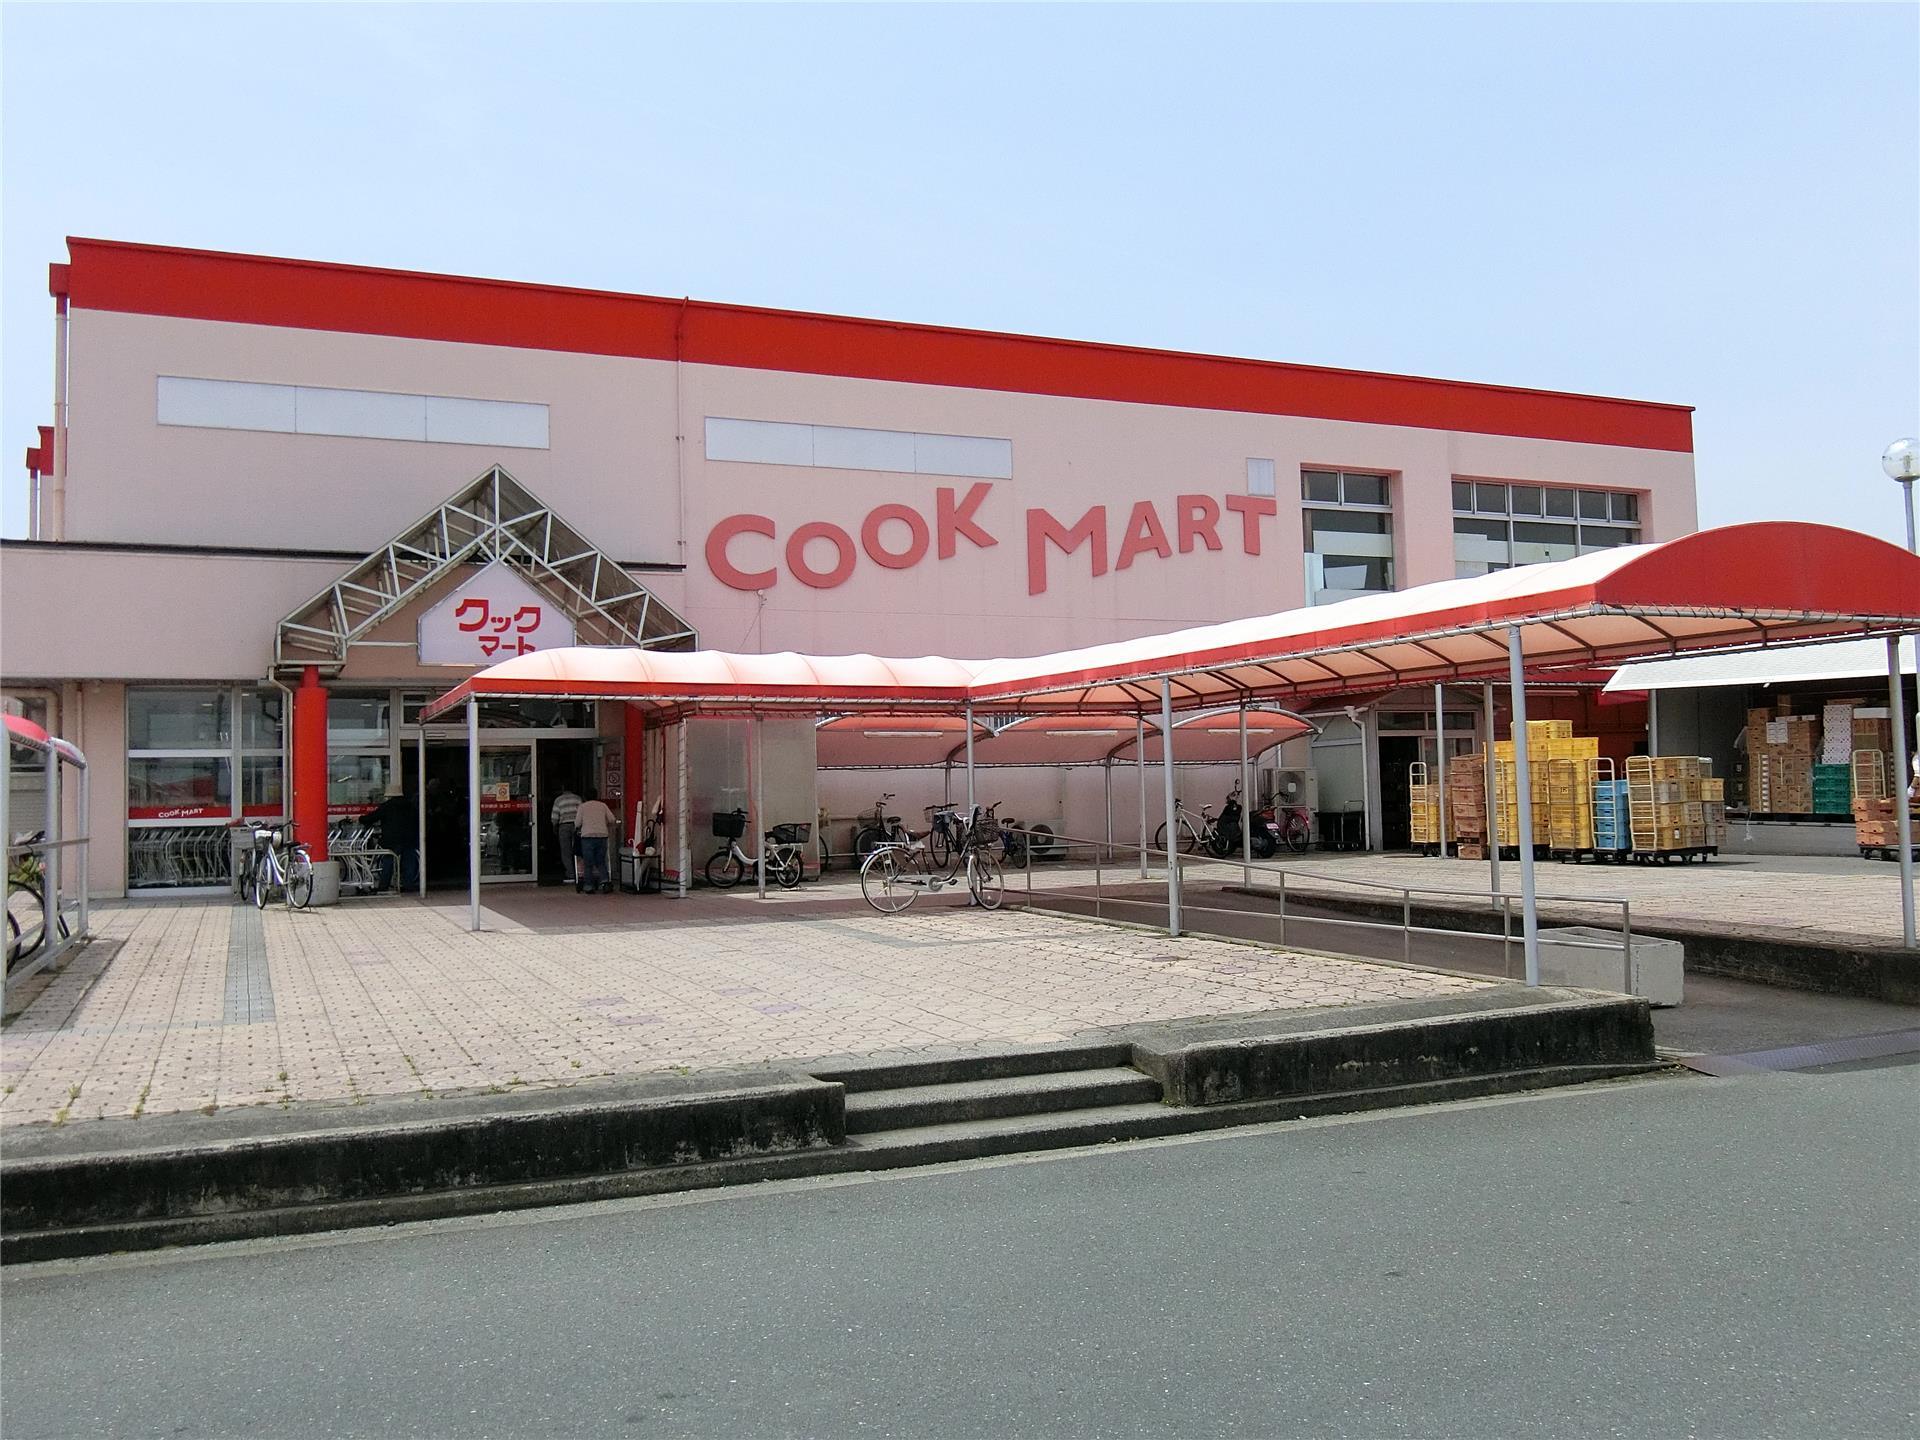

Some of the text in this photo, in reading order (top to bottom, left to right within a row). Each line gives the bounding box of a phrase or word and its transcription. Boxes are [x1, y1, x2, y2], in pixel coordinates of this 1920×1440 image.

[705, 482, 1277, 596] COOK MART
[455, 599, 541, 633] クック
[478, 636, 536, 657] マート
[158, 808, 204, 818] COOK MART
